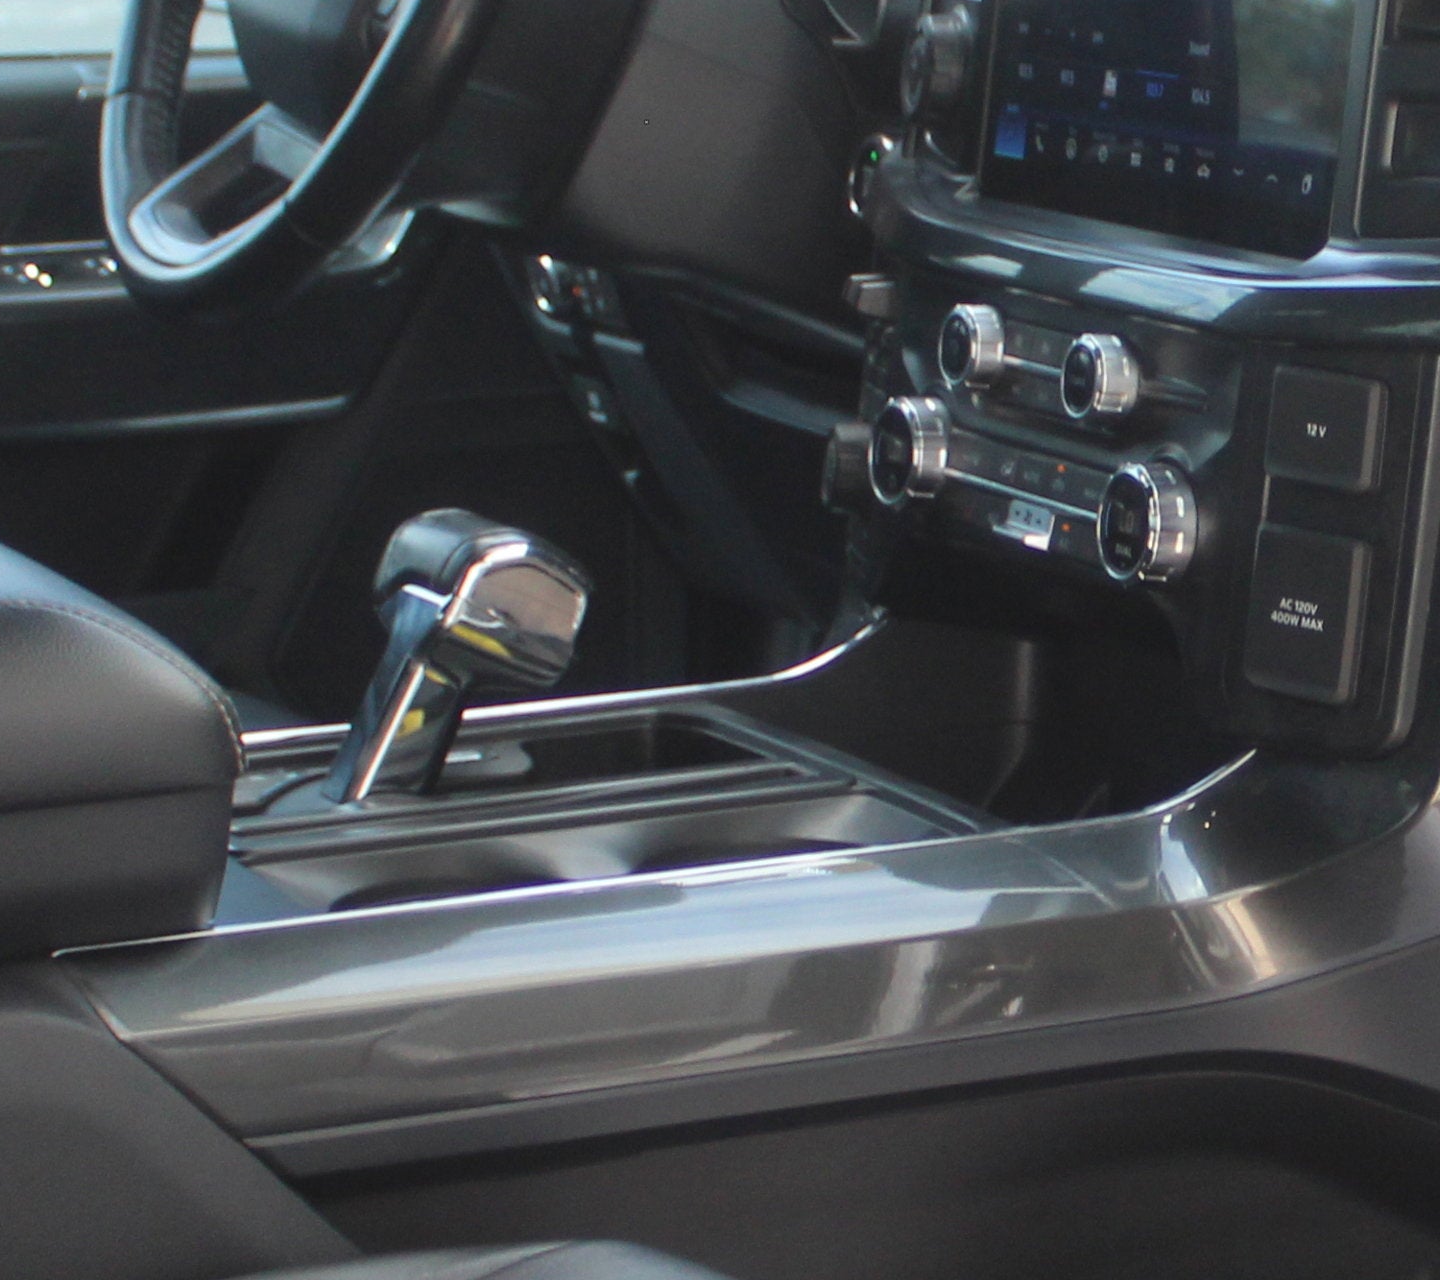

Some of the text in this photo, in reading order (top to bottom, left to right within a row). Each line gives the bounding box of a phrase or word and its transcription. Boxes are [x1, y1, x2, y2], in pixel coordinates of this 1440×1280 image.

[1279, 597, 1318, 616] AC 120V
[1270, 609, 1324, 632] 400W MAX
